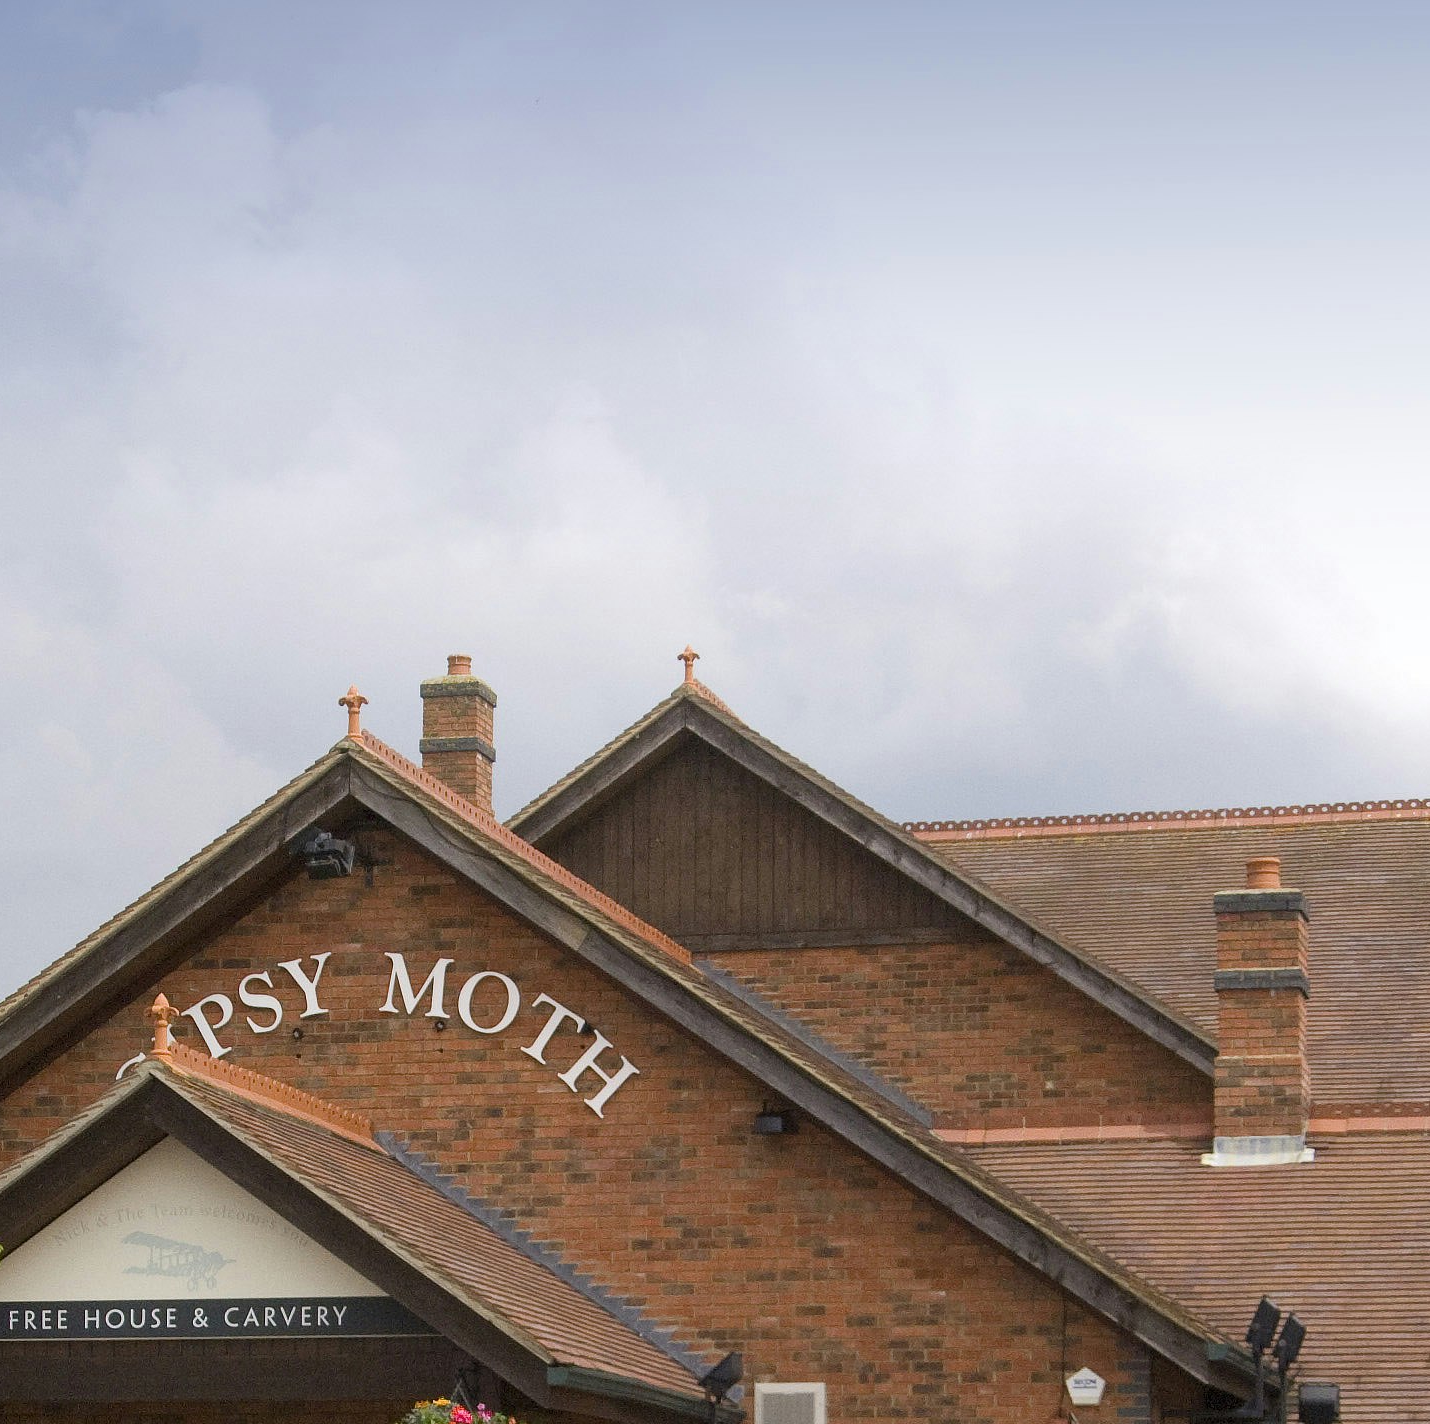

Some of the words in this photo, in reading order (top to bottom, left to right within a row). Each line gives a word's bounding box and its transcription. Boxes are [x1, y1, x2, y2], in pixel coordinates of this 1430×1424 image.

[115, 951, 332, 1081] PSY
[378, 951, 640, 1119] MOTH
[116, 1207, 144, 1224] The
[151, 1202, 193, 1219] Team
[8, 1309, 69, 1331] FREE
[83, 1307, 178, 1330] HOUSE
[191, 1306, 209, 1329] &
[223, 1305, 348, 1329] CARVERY
